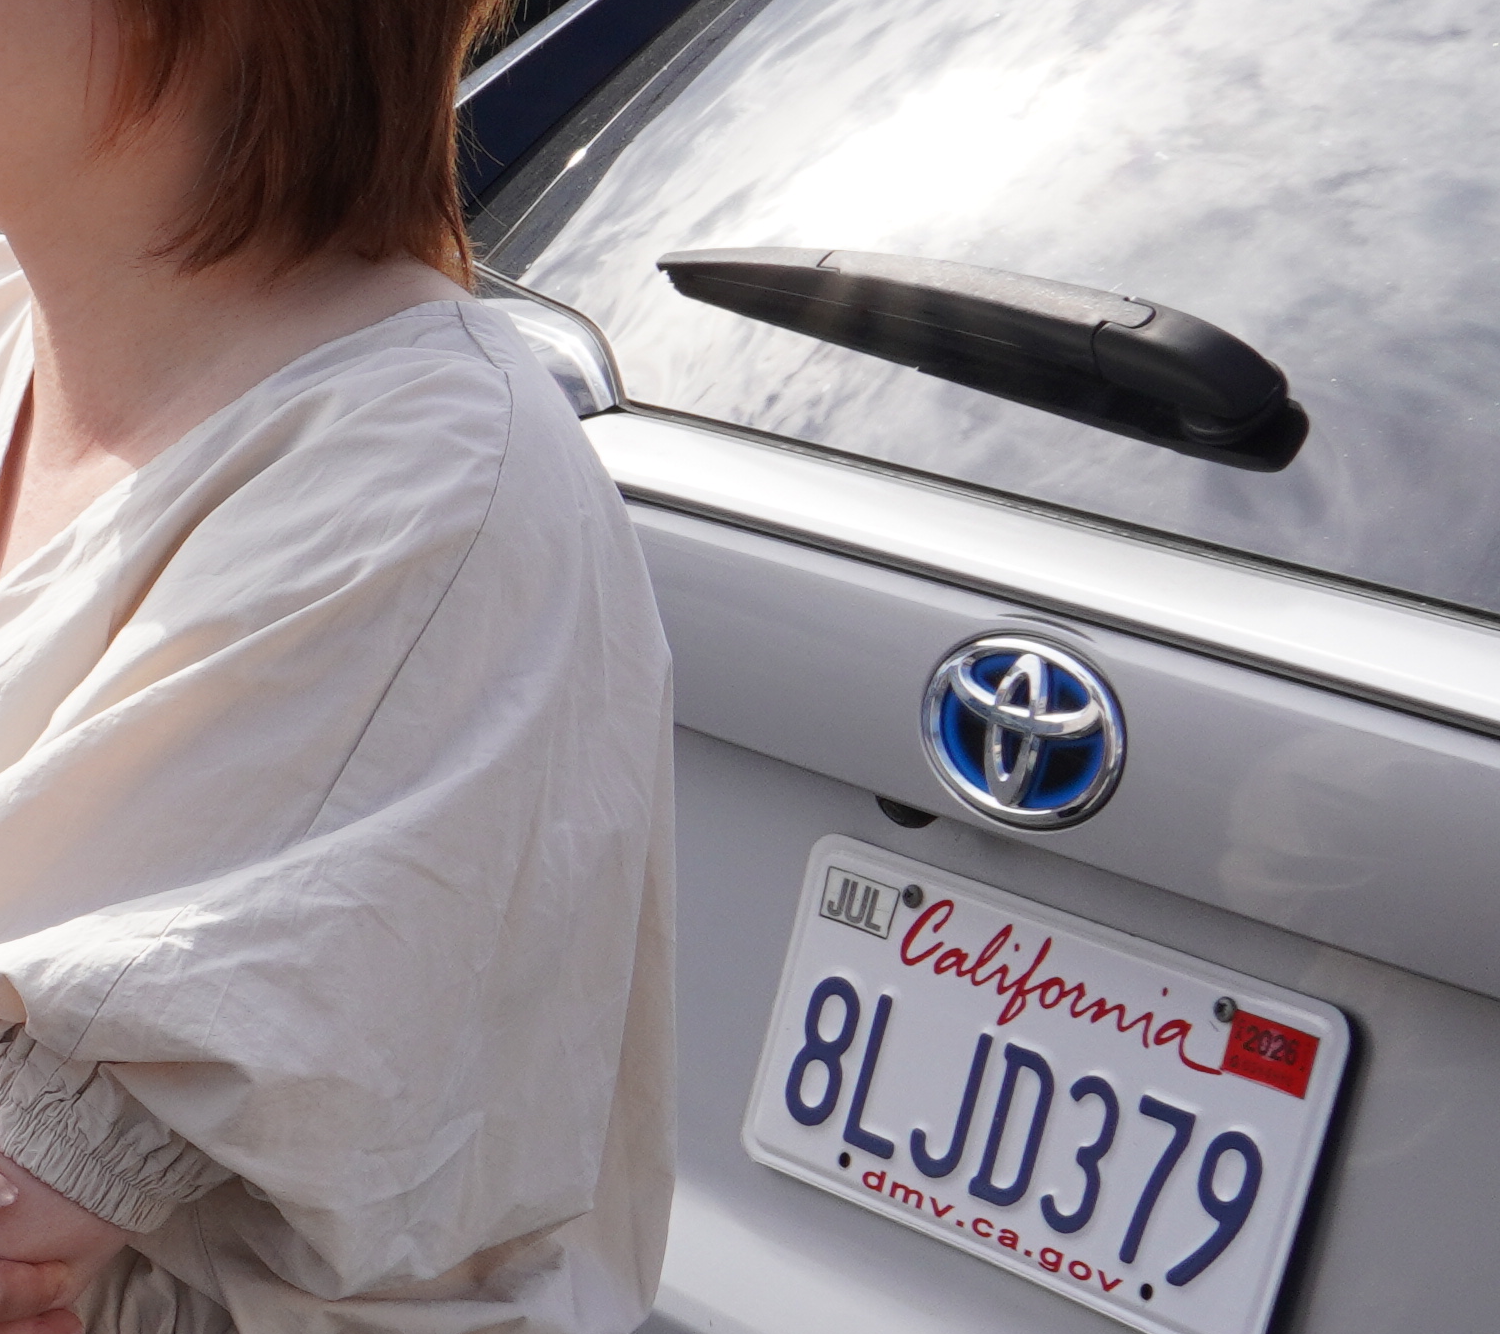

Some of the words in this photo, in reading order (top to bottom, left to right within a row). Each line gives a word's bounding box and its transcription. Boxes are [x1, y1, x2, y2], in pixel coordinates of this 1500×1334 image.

[827, 878, 883, 932] JUL
[900, 899, 1223, 1075] California
[1243, 1025, 1299, 1065] 2026
[784, 976, 1264, 1287] 8LJD379
[862, 1169, 1124, 1293] dmv.ca.gov
